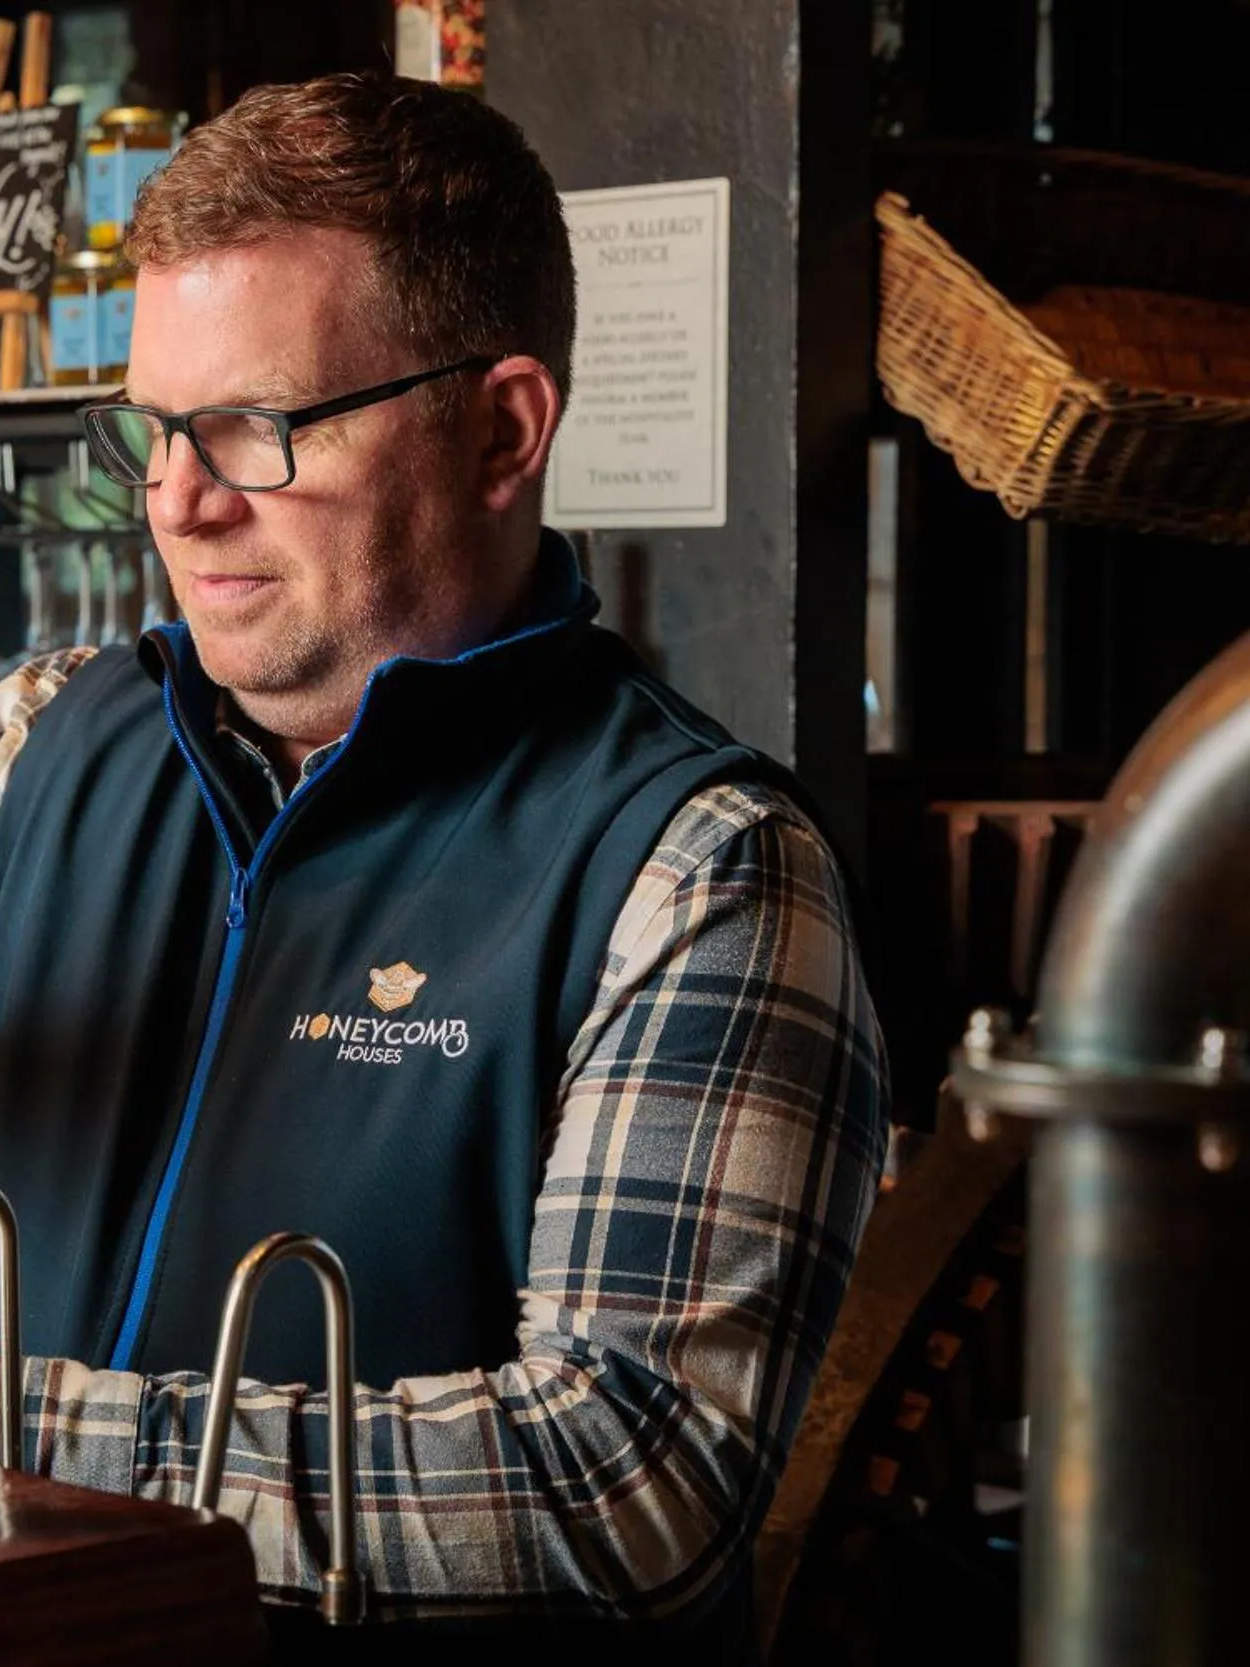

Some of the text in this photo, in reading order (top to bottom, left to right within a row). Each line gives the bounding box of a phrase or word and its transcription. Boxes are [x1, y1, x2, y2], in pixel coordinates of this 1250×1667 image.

[626, 215, 705, 239] ALLERGY
[598, 244, 669, 267] NOTICE
[289, 1012, 469, 1058] HONEYCOMB
[336, 1043, 403, 1064] HOUSES
